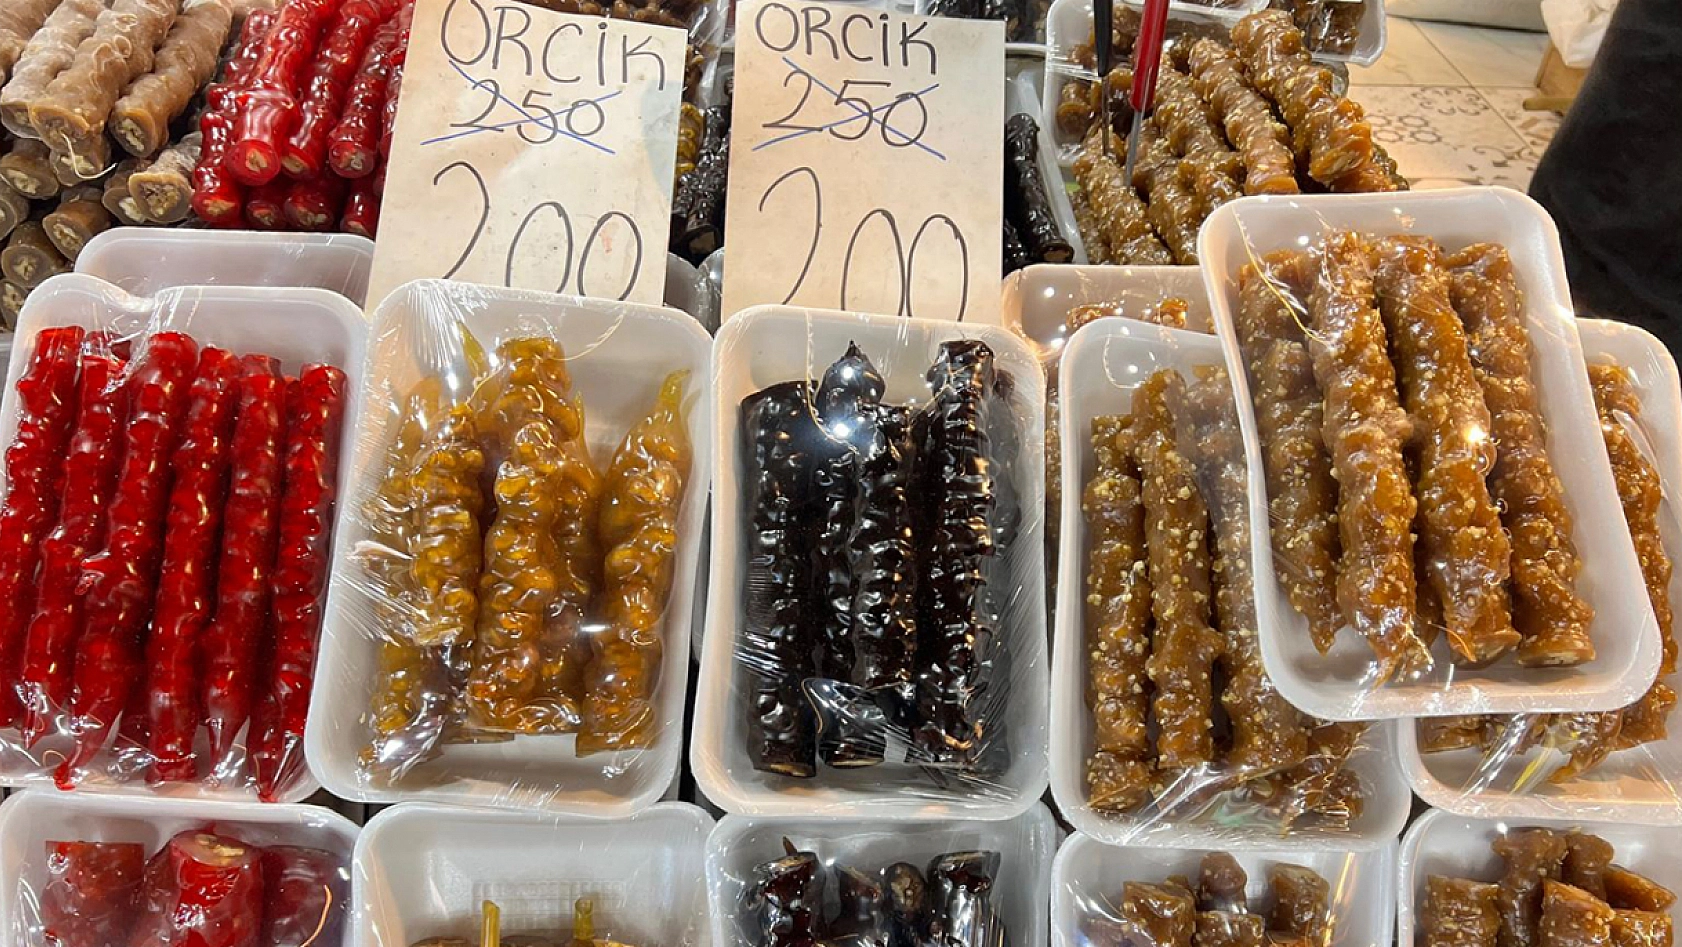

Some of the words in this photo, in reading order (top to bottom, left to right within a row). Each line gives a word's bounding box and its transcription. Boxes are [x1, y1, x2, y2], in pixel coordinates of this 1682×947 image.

[449, 79, 605, 144] 250
[763, 71, 928, 146] 250
[433, 161, 643, 302] 200
